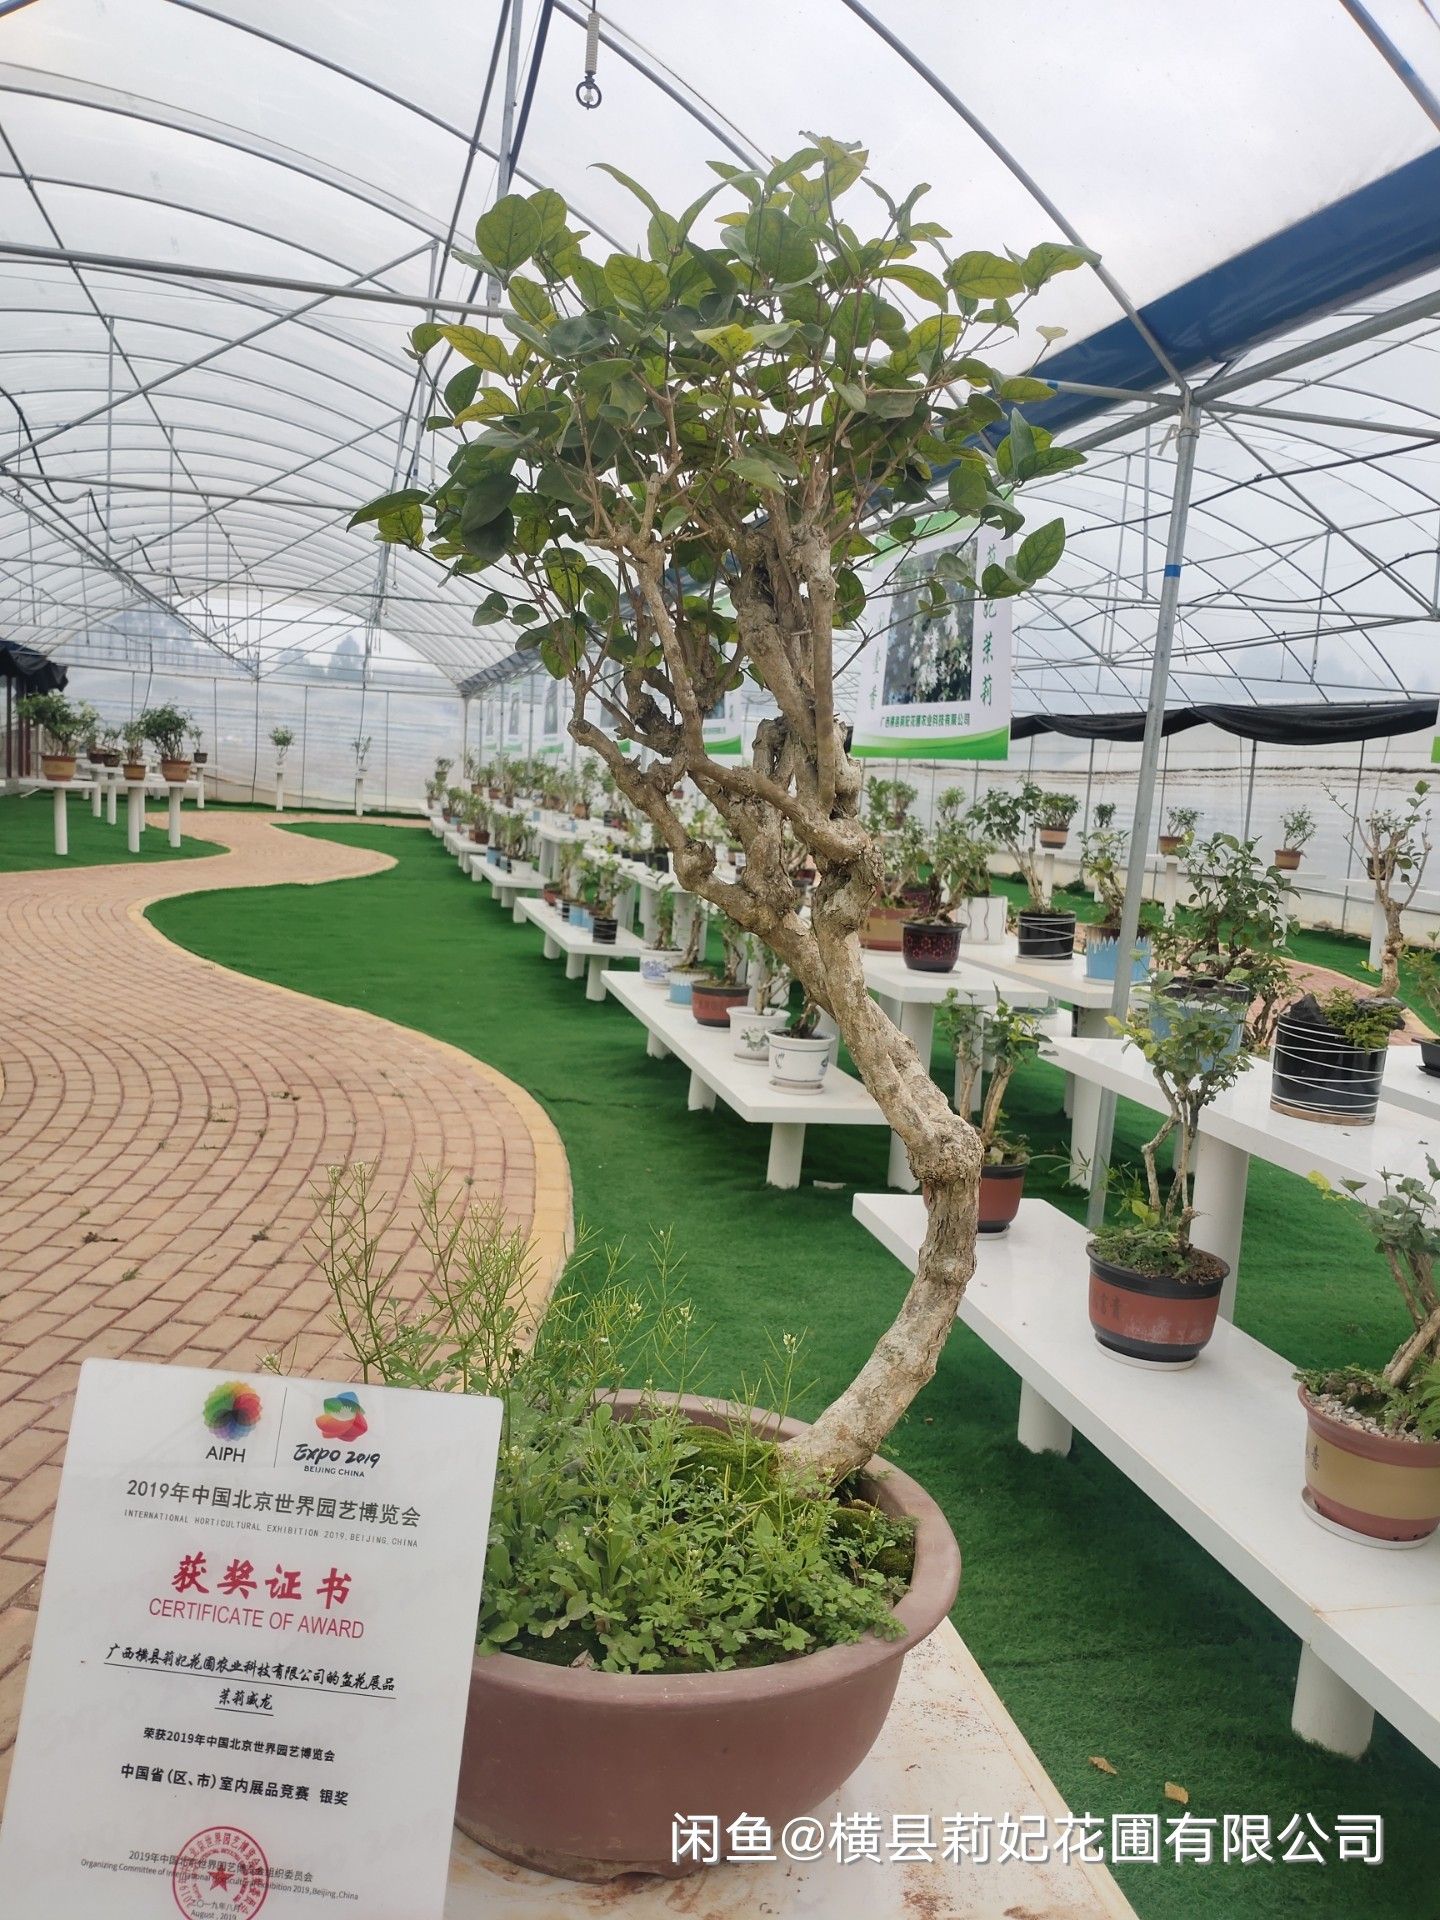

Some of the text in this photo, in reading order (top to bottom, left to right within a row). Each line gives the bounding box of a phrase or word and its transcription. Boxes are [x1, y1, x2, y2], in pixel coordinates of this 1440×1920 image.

[206, 1445, 246, 1463] AIPH
[344, 1450, 381, 1469] 2019
[303, 1465, 365, 1478] BEIJING CHINA
[127, 1479, 421, 1529] 2019年中国北京世界园艺博览会
[124, 1509, 188, 1524] INTERNATIONAL
[194, 1517, 261, 1531] HORTICULTURAL
[266, 1524, 319, 1537] EXHIBITION
[171, 1551, 352, 1610] 获奖证书
[149, 1597, 364, 1639] CERTIFICATE OF AWARD
[143, 1727, 335, 1762] 荣获2019年中国北京世界园艺博览会
[319, 1788, 349, 1806] 银奖
[81, 1858, 118, 1871] Organizing
[118, 1863, 157, 1875] Committee
[157, 1868, 166, 1876] of
